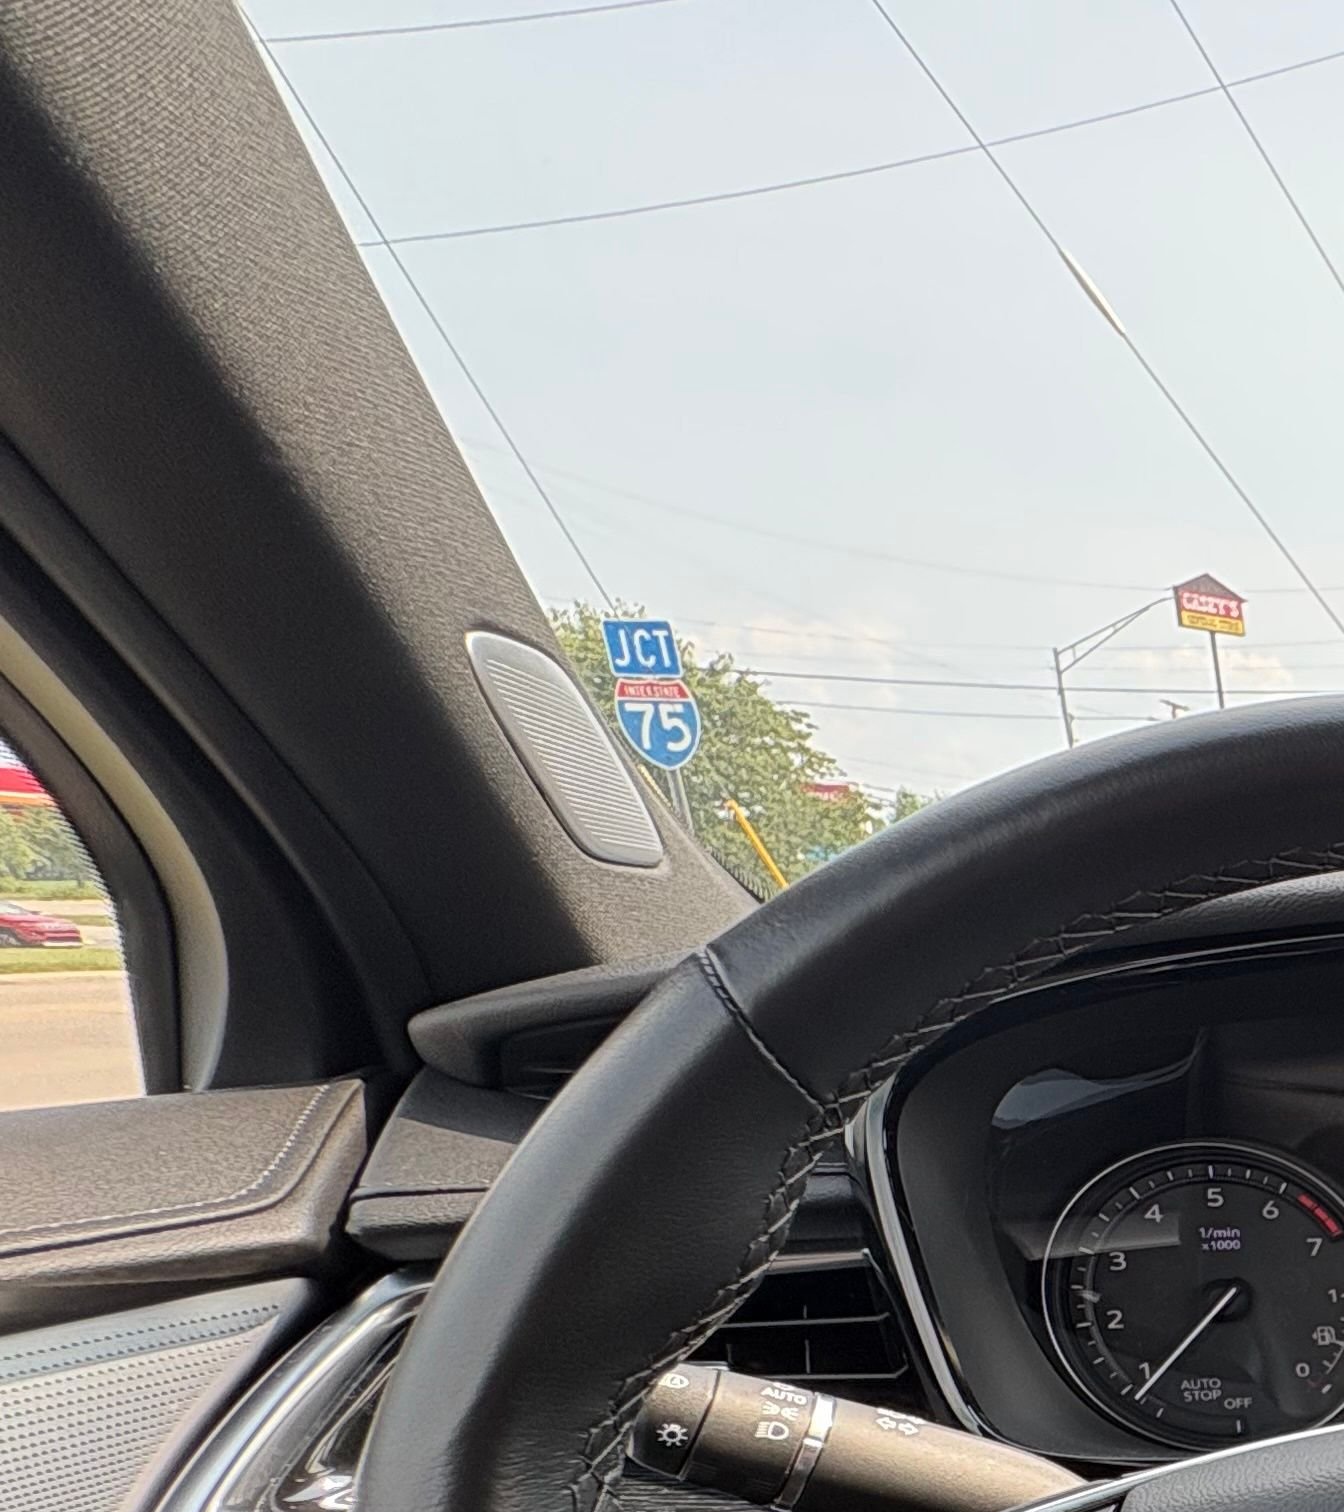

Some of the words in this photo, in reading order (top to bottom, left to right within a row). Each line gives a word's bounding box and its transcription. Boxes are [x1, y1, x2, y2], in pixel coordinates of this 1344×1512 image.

[614, 628, 671, 668] JCT
[623, 684, 681, 698] INTERSTATE
[624, 702, 692, 753] 75
[1207, 1187, 1225, 1208] 5
[1144, 1204, 1165, 1223] 4
[1261, 1200, 1281, 1221] 6
[1198, 1226, 1241, 1240] 1/min
[1202, 1239, 1241, 1251] x1000
[1306, 1237, 1324, 1257] 7
[1108, 1251, 1128, 1271] 3
[1328, 1288, 1339, 1303] 1
[1106, 1309, 1125, 1330] 2
[1138, 1360, 1152, 1380] 1
[1295, 1362, 1311, 1379] 0
[1180, 1377, 1222, 1391] AUTO
[760, 1386, 808, 1405] AUTO
[1183, 1389, 1222, 1402] STOP
[1223, 1396, 1253, 1410] OFF
